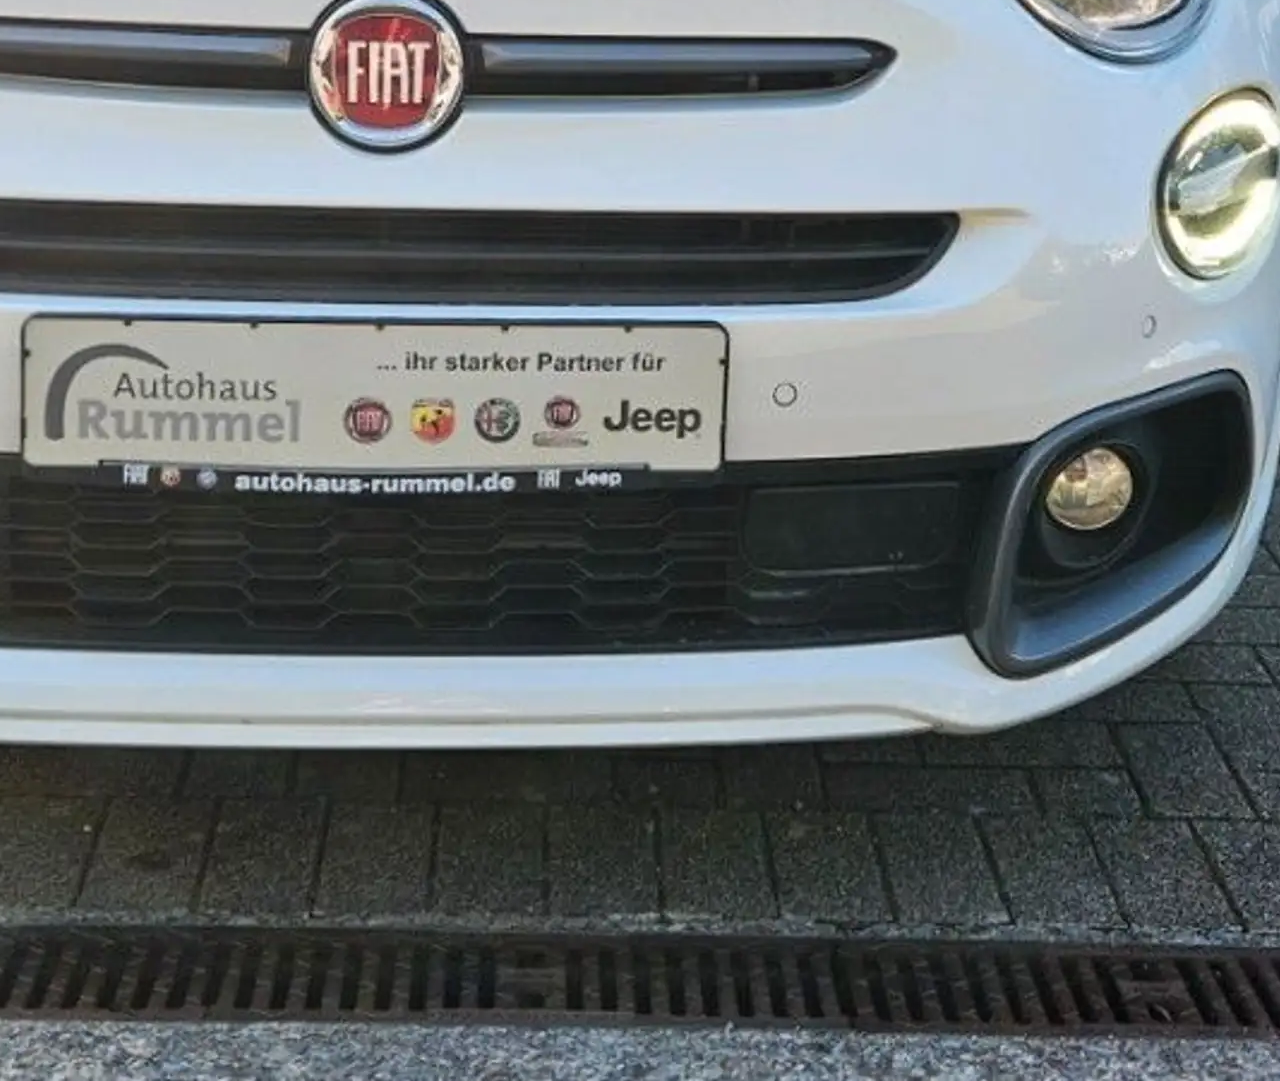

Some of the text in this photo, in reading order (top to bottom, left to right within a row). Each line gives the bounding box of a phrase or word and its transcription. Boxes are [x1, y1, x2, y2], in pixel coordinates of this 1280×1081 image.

[347, 40, 431, 104] FIAT
[405, 352, 438, 372] ihr
[445, 352, 530, 372] starker
[537, 353, 630, 372] Partner
[632, 352, 667, 372] für
[113, 372, 278, 401] Autohaus
[76, 399, 302, 443] Rummel
[603, 399, 702, 439] Jeep
[233, 471, 517, 494] autohaus-rummel.de
[575, 468, 622, 488] Jeep
